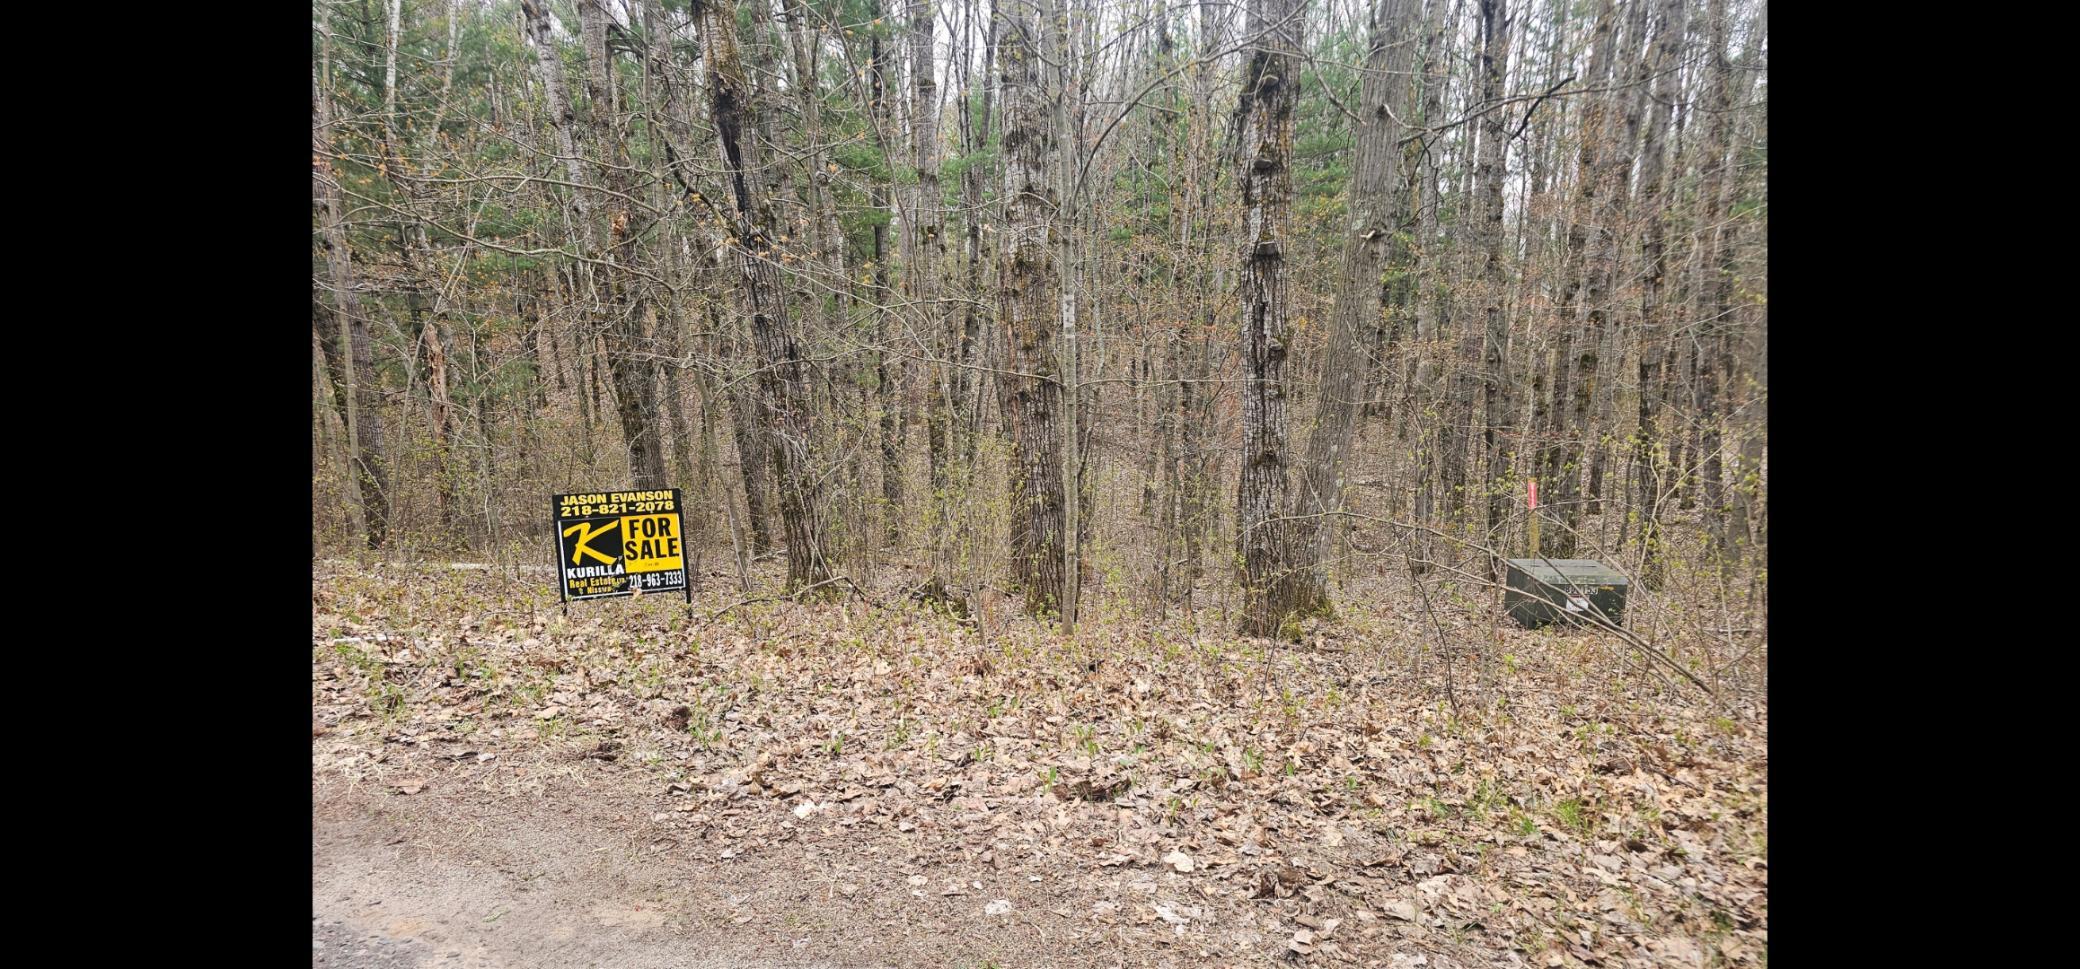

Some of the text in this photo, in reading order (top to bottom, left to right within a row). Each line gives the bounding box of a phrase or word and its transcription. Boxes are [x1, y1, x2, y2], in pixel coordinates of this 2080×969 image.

[560, 490, 673, 506] JASON EVANSON
[560, 501, 675, 517] 218-821-2078
[628, 517, 672, 539] FOR
[563, 520, 619, 566] K
[625, 538, 679, 561] SALE
[567, 563, 625, 579] KURILLA
[570, 579, 588, 589] Real
[590, 576, 616, 587] Estate
[629, 571, 683, 588] 218-963-7333
